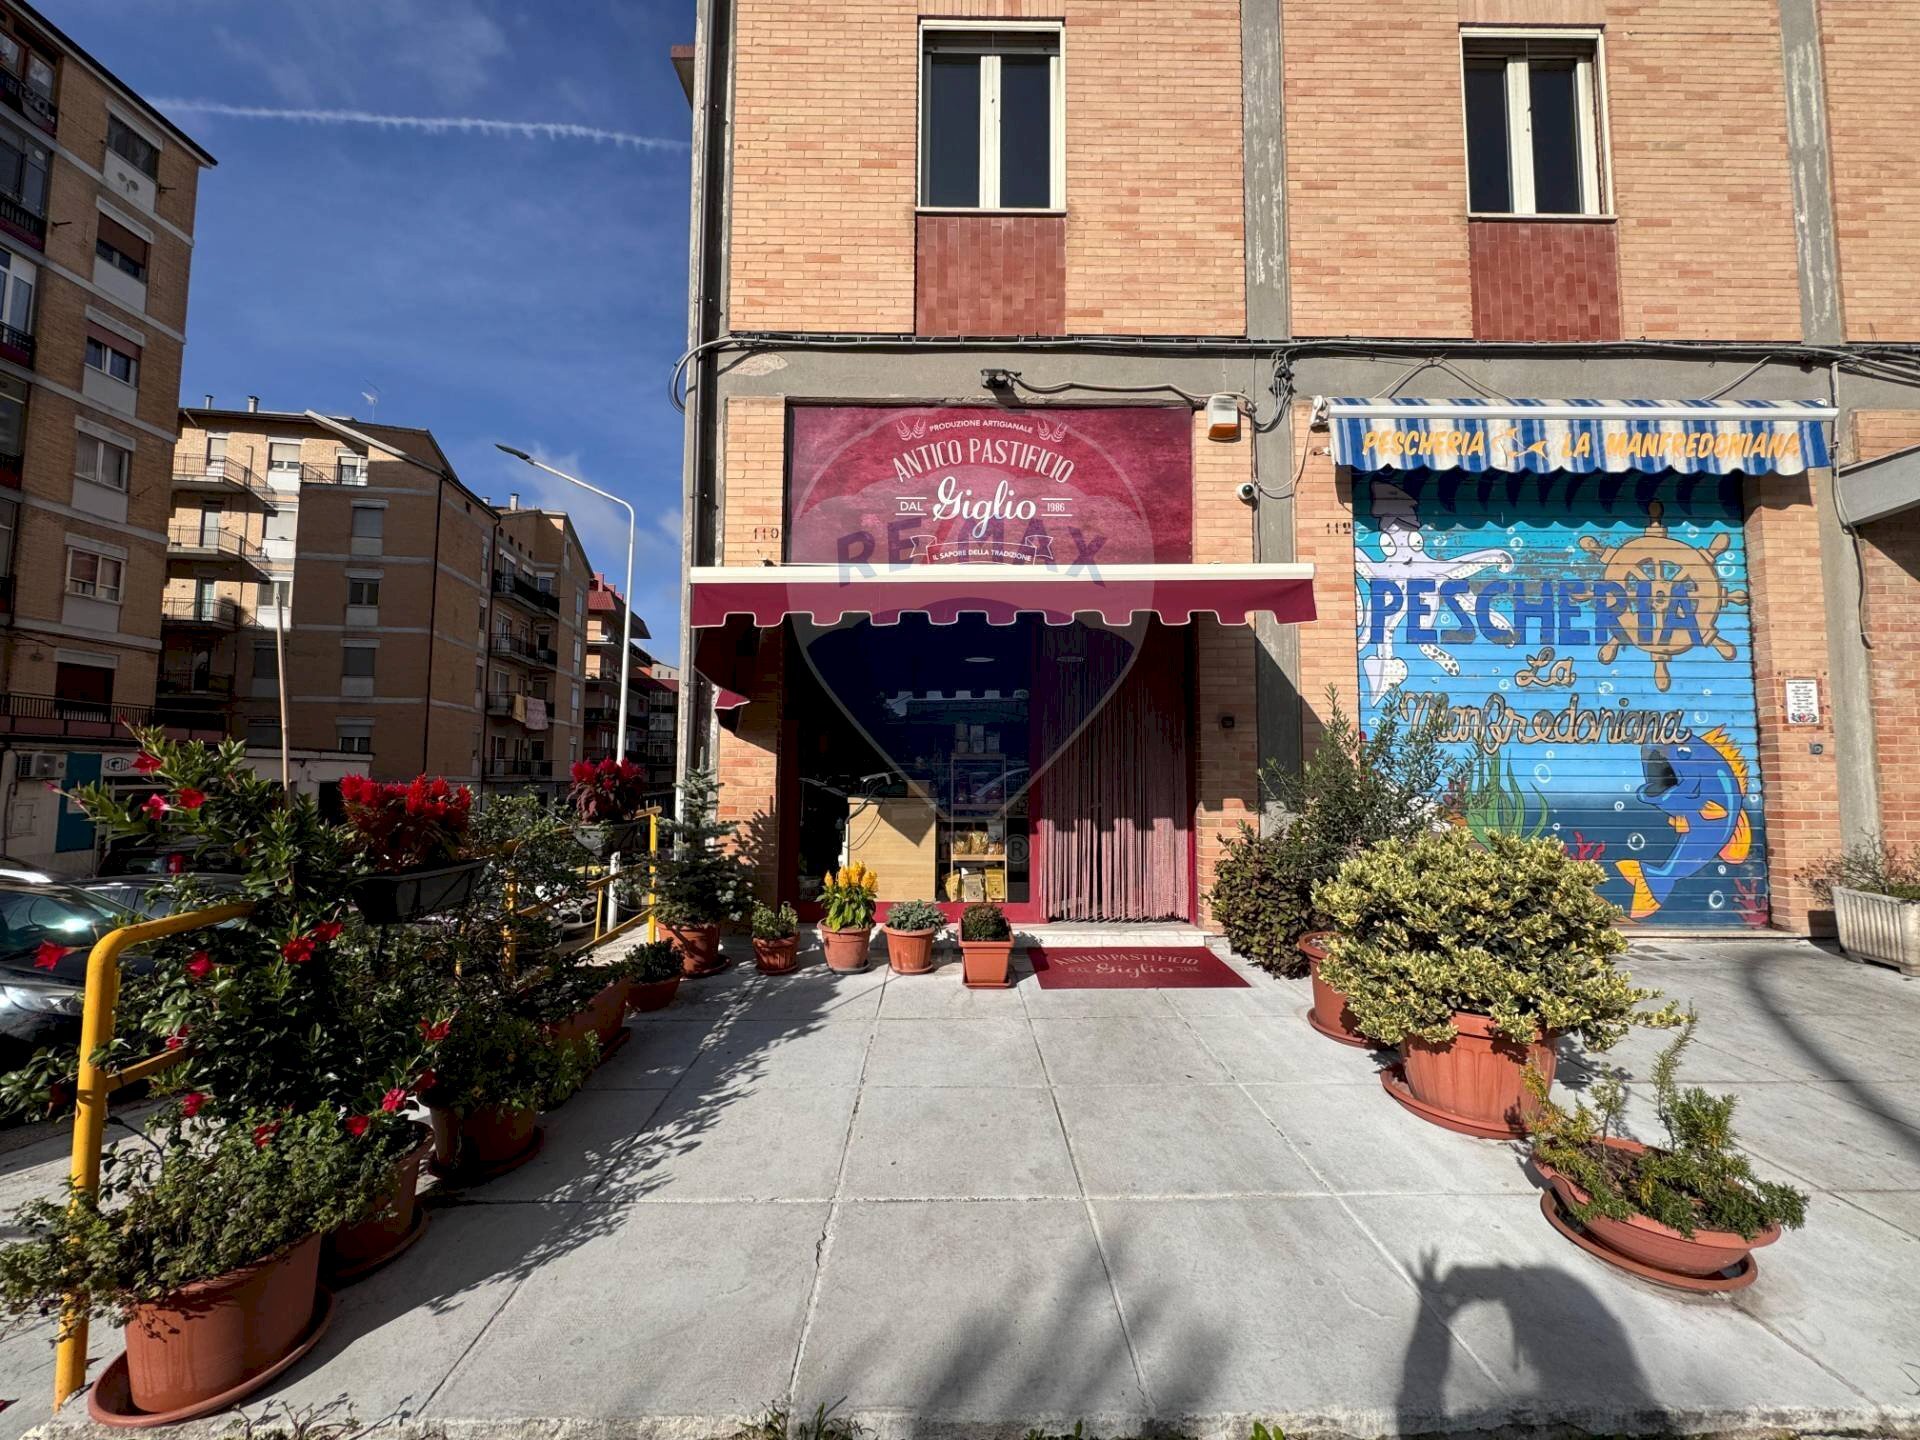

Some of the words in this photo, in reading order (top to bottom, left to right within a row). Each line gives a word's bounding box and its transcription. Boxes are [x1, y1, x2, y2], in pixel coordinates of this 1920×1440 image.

[929, 419, 981, 433] PRODUZIONE
[982, 419, 1033, 434] ARTIGIANALE
[1362, 431, 1485, 456] PESCHERIA
[1561, 432, 1591, 458] LA
[1606, 432, 1800, 458] MANFREDONIANA
[892, 439, 962, 483] ANTICO
[969, 438, 1075, 483] PASTIFICIO
[900, 501, 923, 512] DAL
[932, 476, 1037, 539] Giglio
[1047, 502, 1066, 513] 1986
[754, 527, 780, 541] 110
[1326, 522, 1352, 535] 112
[932, 552, 939, 561] IL
[939, 550, 967, 561] SAPORE
[991, 549, 1032, 562] TRADIZIONE
[1370, 579, 1707, 646] PESCHERIA
[1515, 647, 1577, 688] La
[1400, 692, 1691, 754] Manfredoniana
[1110, 953, 1199, 965] PASTIFICIO
[1095, 962, 1174, 978] Giglio
